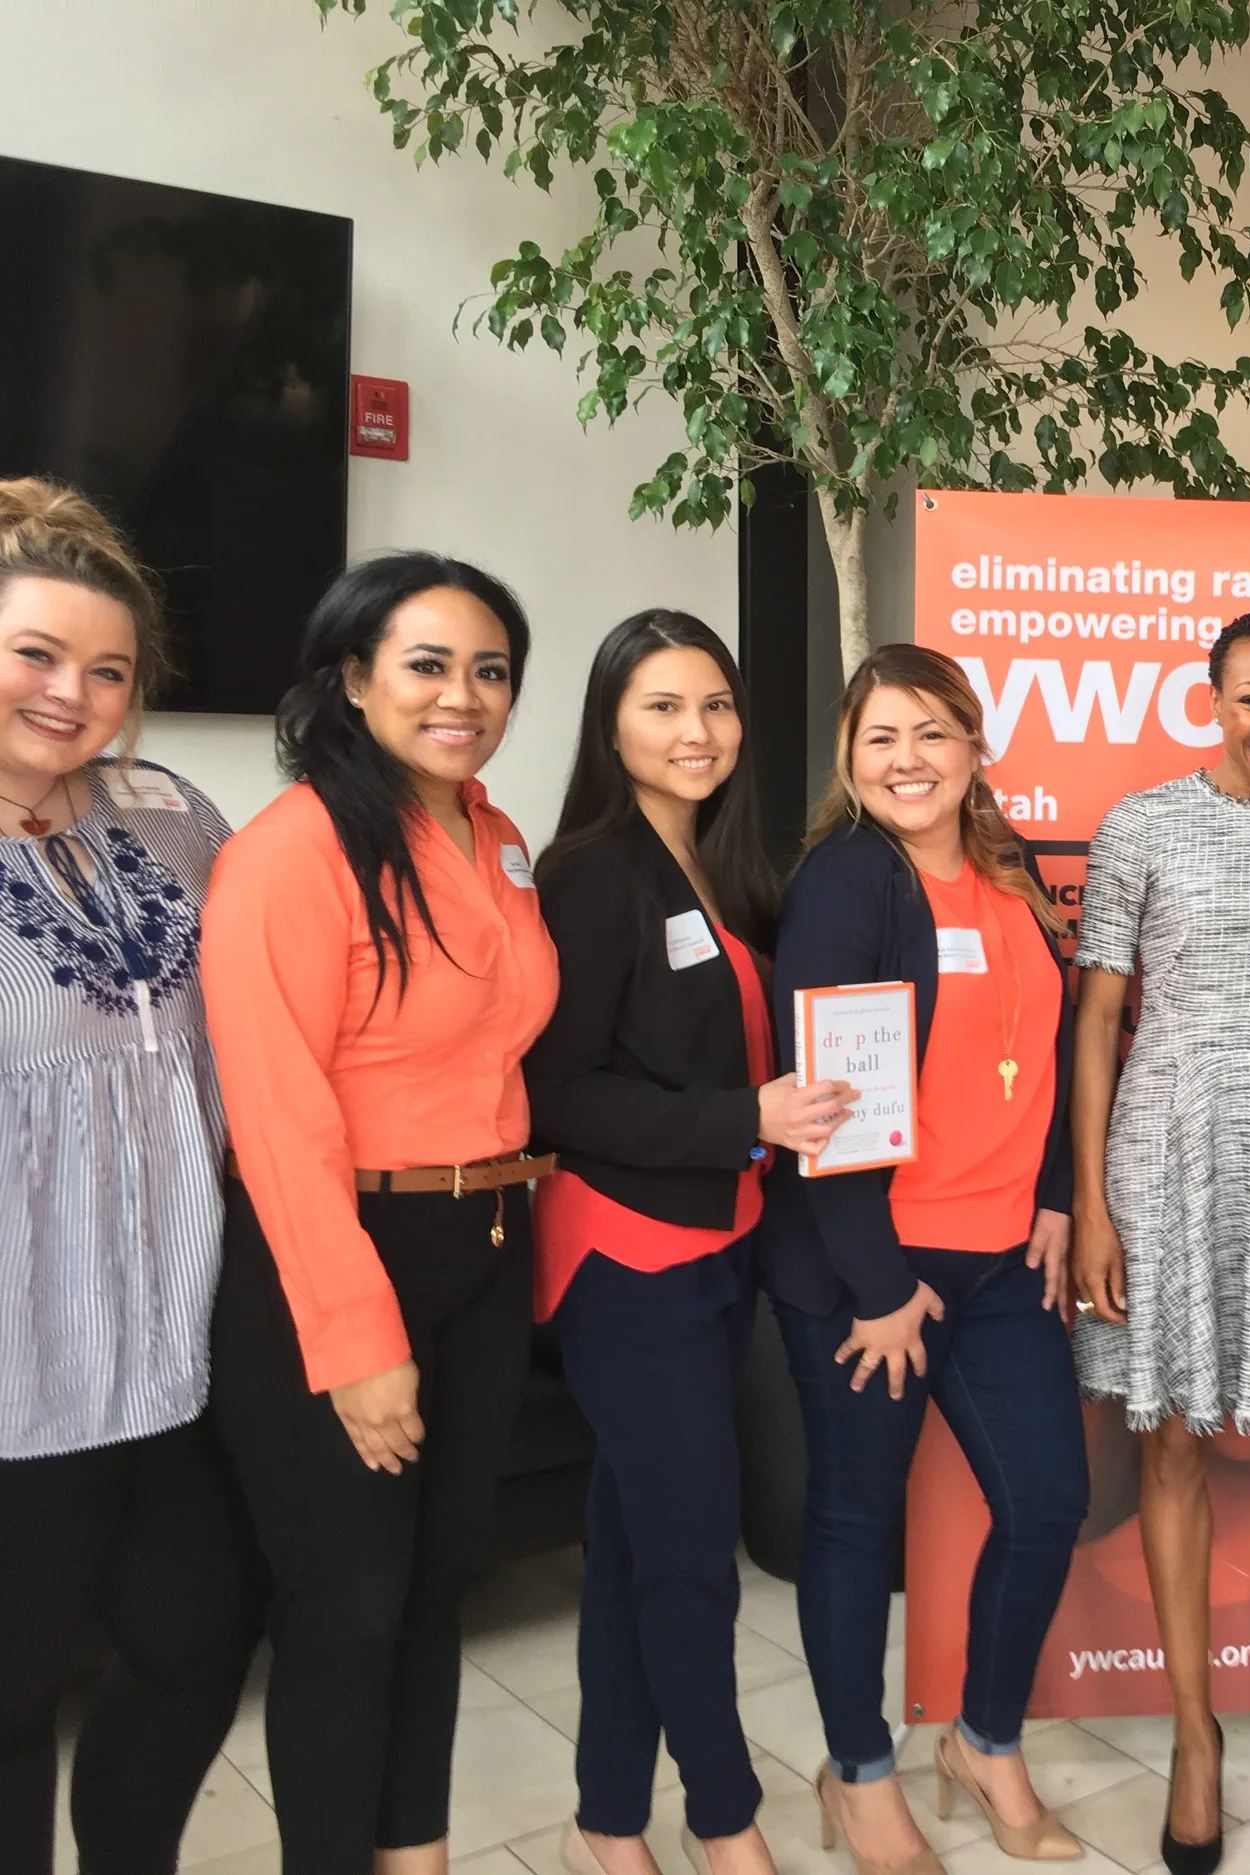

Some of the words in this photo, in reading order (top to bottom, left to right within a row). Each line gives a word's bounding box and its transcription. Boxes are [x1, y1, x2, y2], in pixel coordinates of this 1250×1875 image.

[365, 412, 394, 426] FIRE
[951, 555, 1196, 603] eliminating
[951, 607, 1222, 649] empowering
[993, 786, 1057, 821] tah
[873, 1026, 902, 1043] the
[846, 1054, 880, 1074] ball
[873, 1100, 905, 1117] dufu
